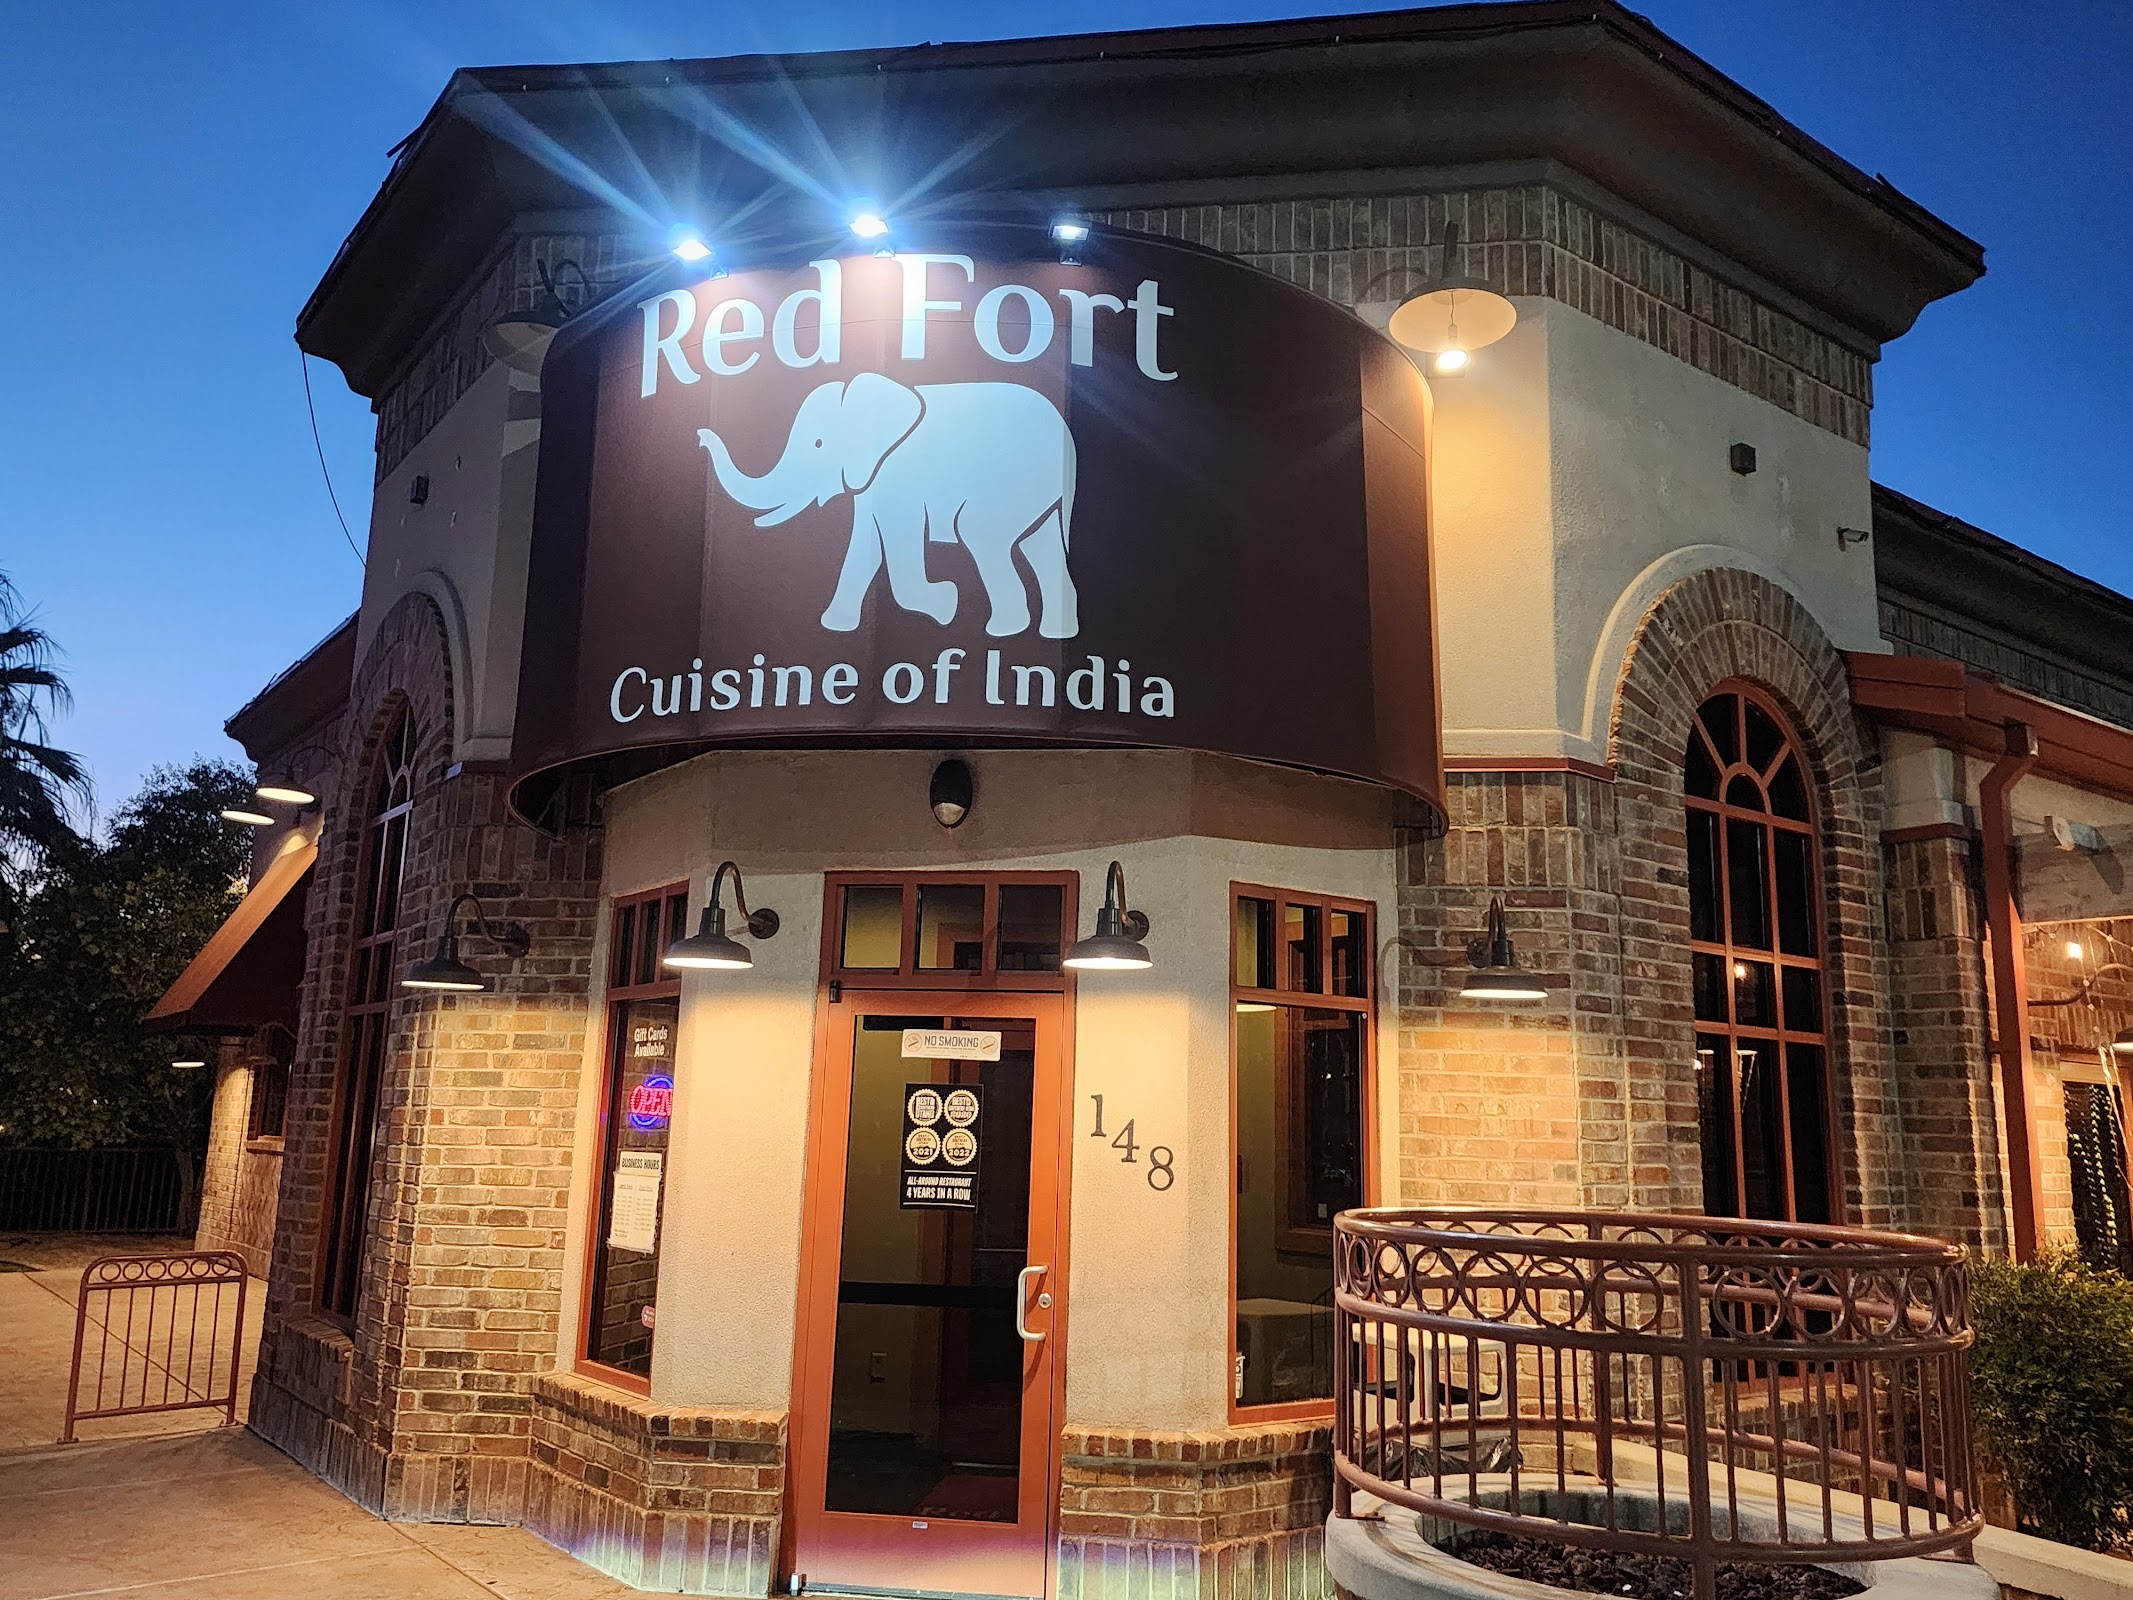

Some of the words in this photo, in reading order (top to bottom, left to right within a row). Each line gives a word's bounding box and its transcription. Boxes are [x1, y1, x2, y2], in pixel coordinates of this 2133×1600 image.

[636, 260, 843, 400] Red
[893, 253, 1179, 382] Fort
[609, 653, 860, 724] Cuisine
[881, 647, 967, 705] of
[985, 649, 1176, 719] India
[634, 1027, 647, 1042] Gift
[647, 1026, 668, 1041] Cards
[924, 1035, 937, 1046] NO
[939, 1036, 979, 1048] SMOKING
[634, 1042, 665, 1057] Available
[630, 1085, 673, 1116] OPEN
[949, 1149, 970, 1157] 2022
[621, 1158, 643, 1169] BUSINESS
[643, 1159, 660, 1170] HOURS
[907, 1176, 939, 1185] ALL-AROUND
[939, 1177, 972, 1187] RESTAURANT
[906, 1187, 912, 1198] 4
[913, 1187, 936, 1199] YEARS
[937, 1188, 946, 1199] IN
[947, 1188, 952, 1199] A
[953, 1188, 971, 1201] ROW
